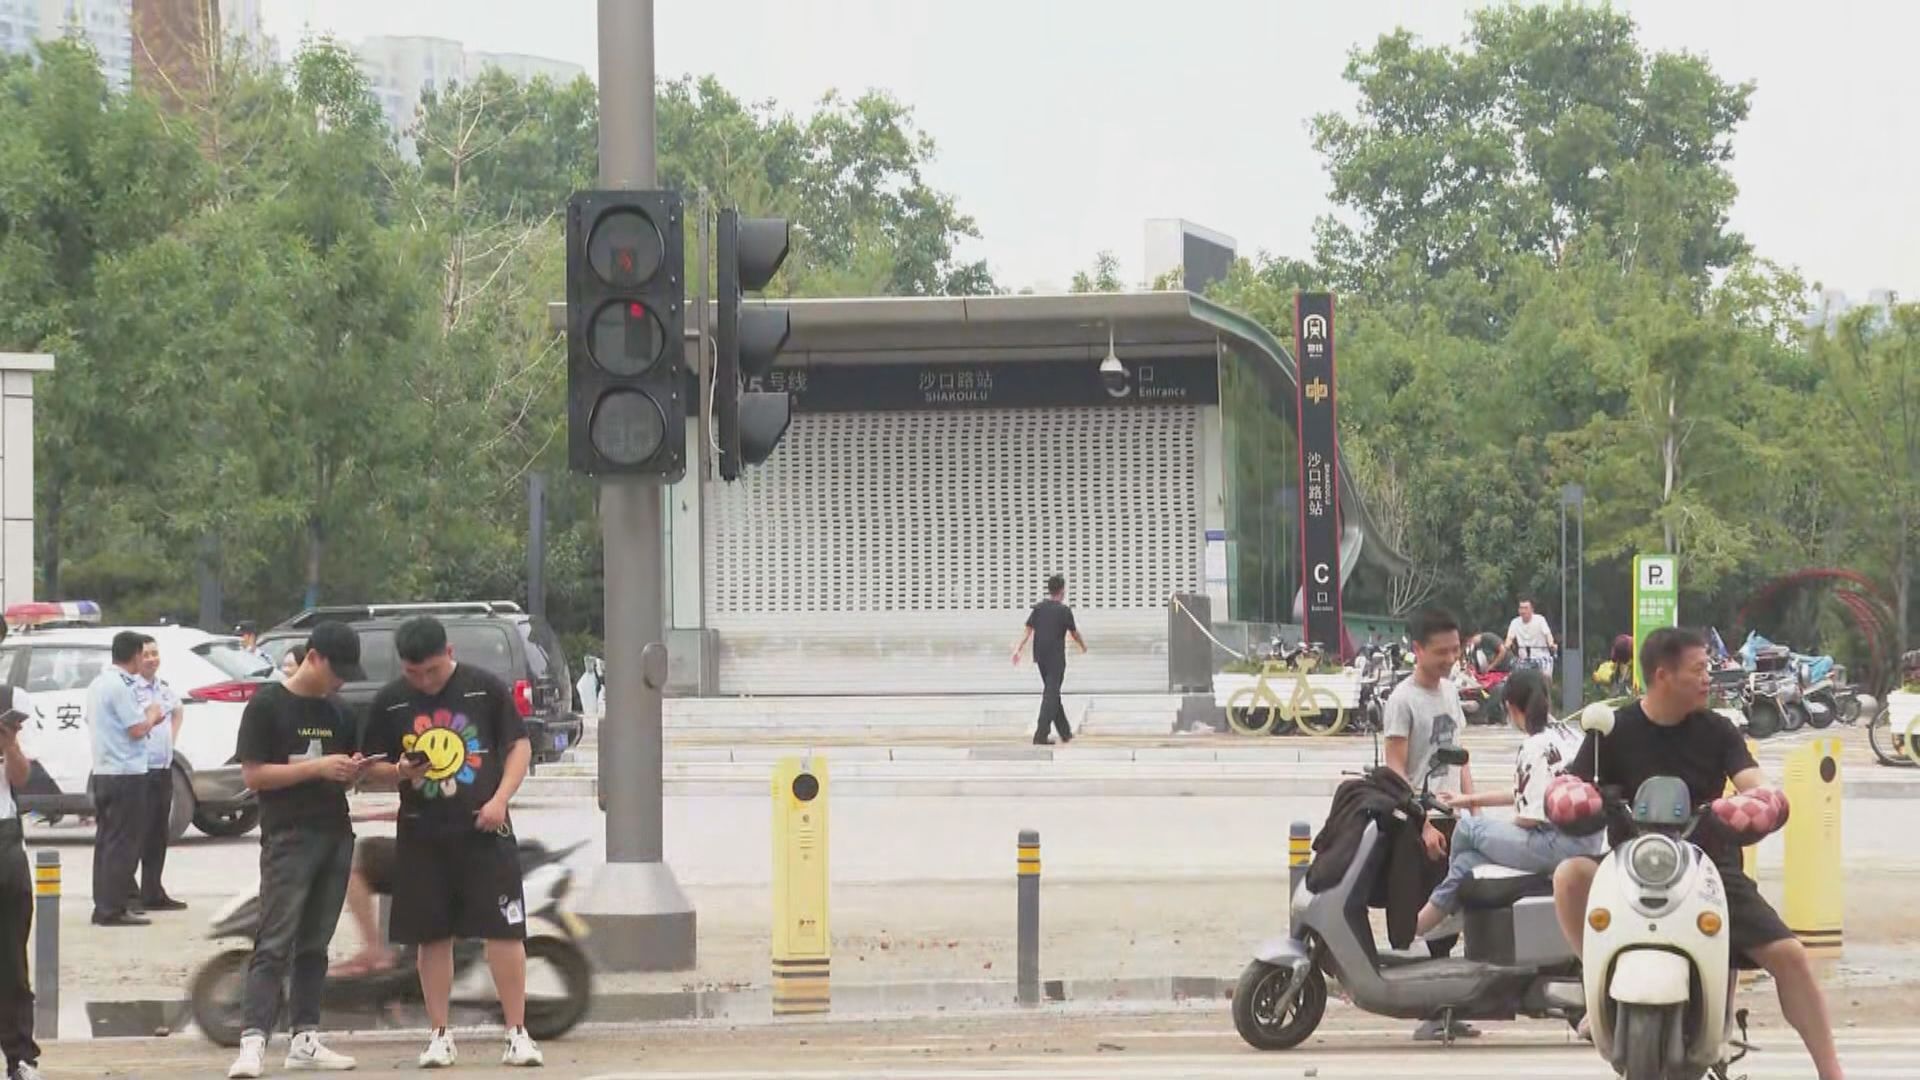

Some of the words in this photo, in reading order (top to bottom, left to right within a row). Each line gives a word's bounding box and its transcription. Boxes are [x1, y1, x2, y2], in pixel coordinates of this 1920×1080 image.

[919, 370, 993, 391] 沙口路站
[925, 390, 988, 402] SHAKOULU
[1138, 386, 1187, 399] Entrance
[1307, 451, 1323, 516] 沙口路站
[1313, 563, 1329, 584] C
[1648, 565, 1664, 585] P
